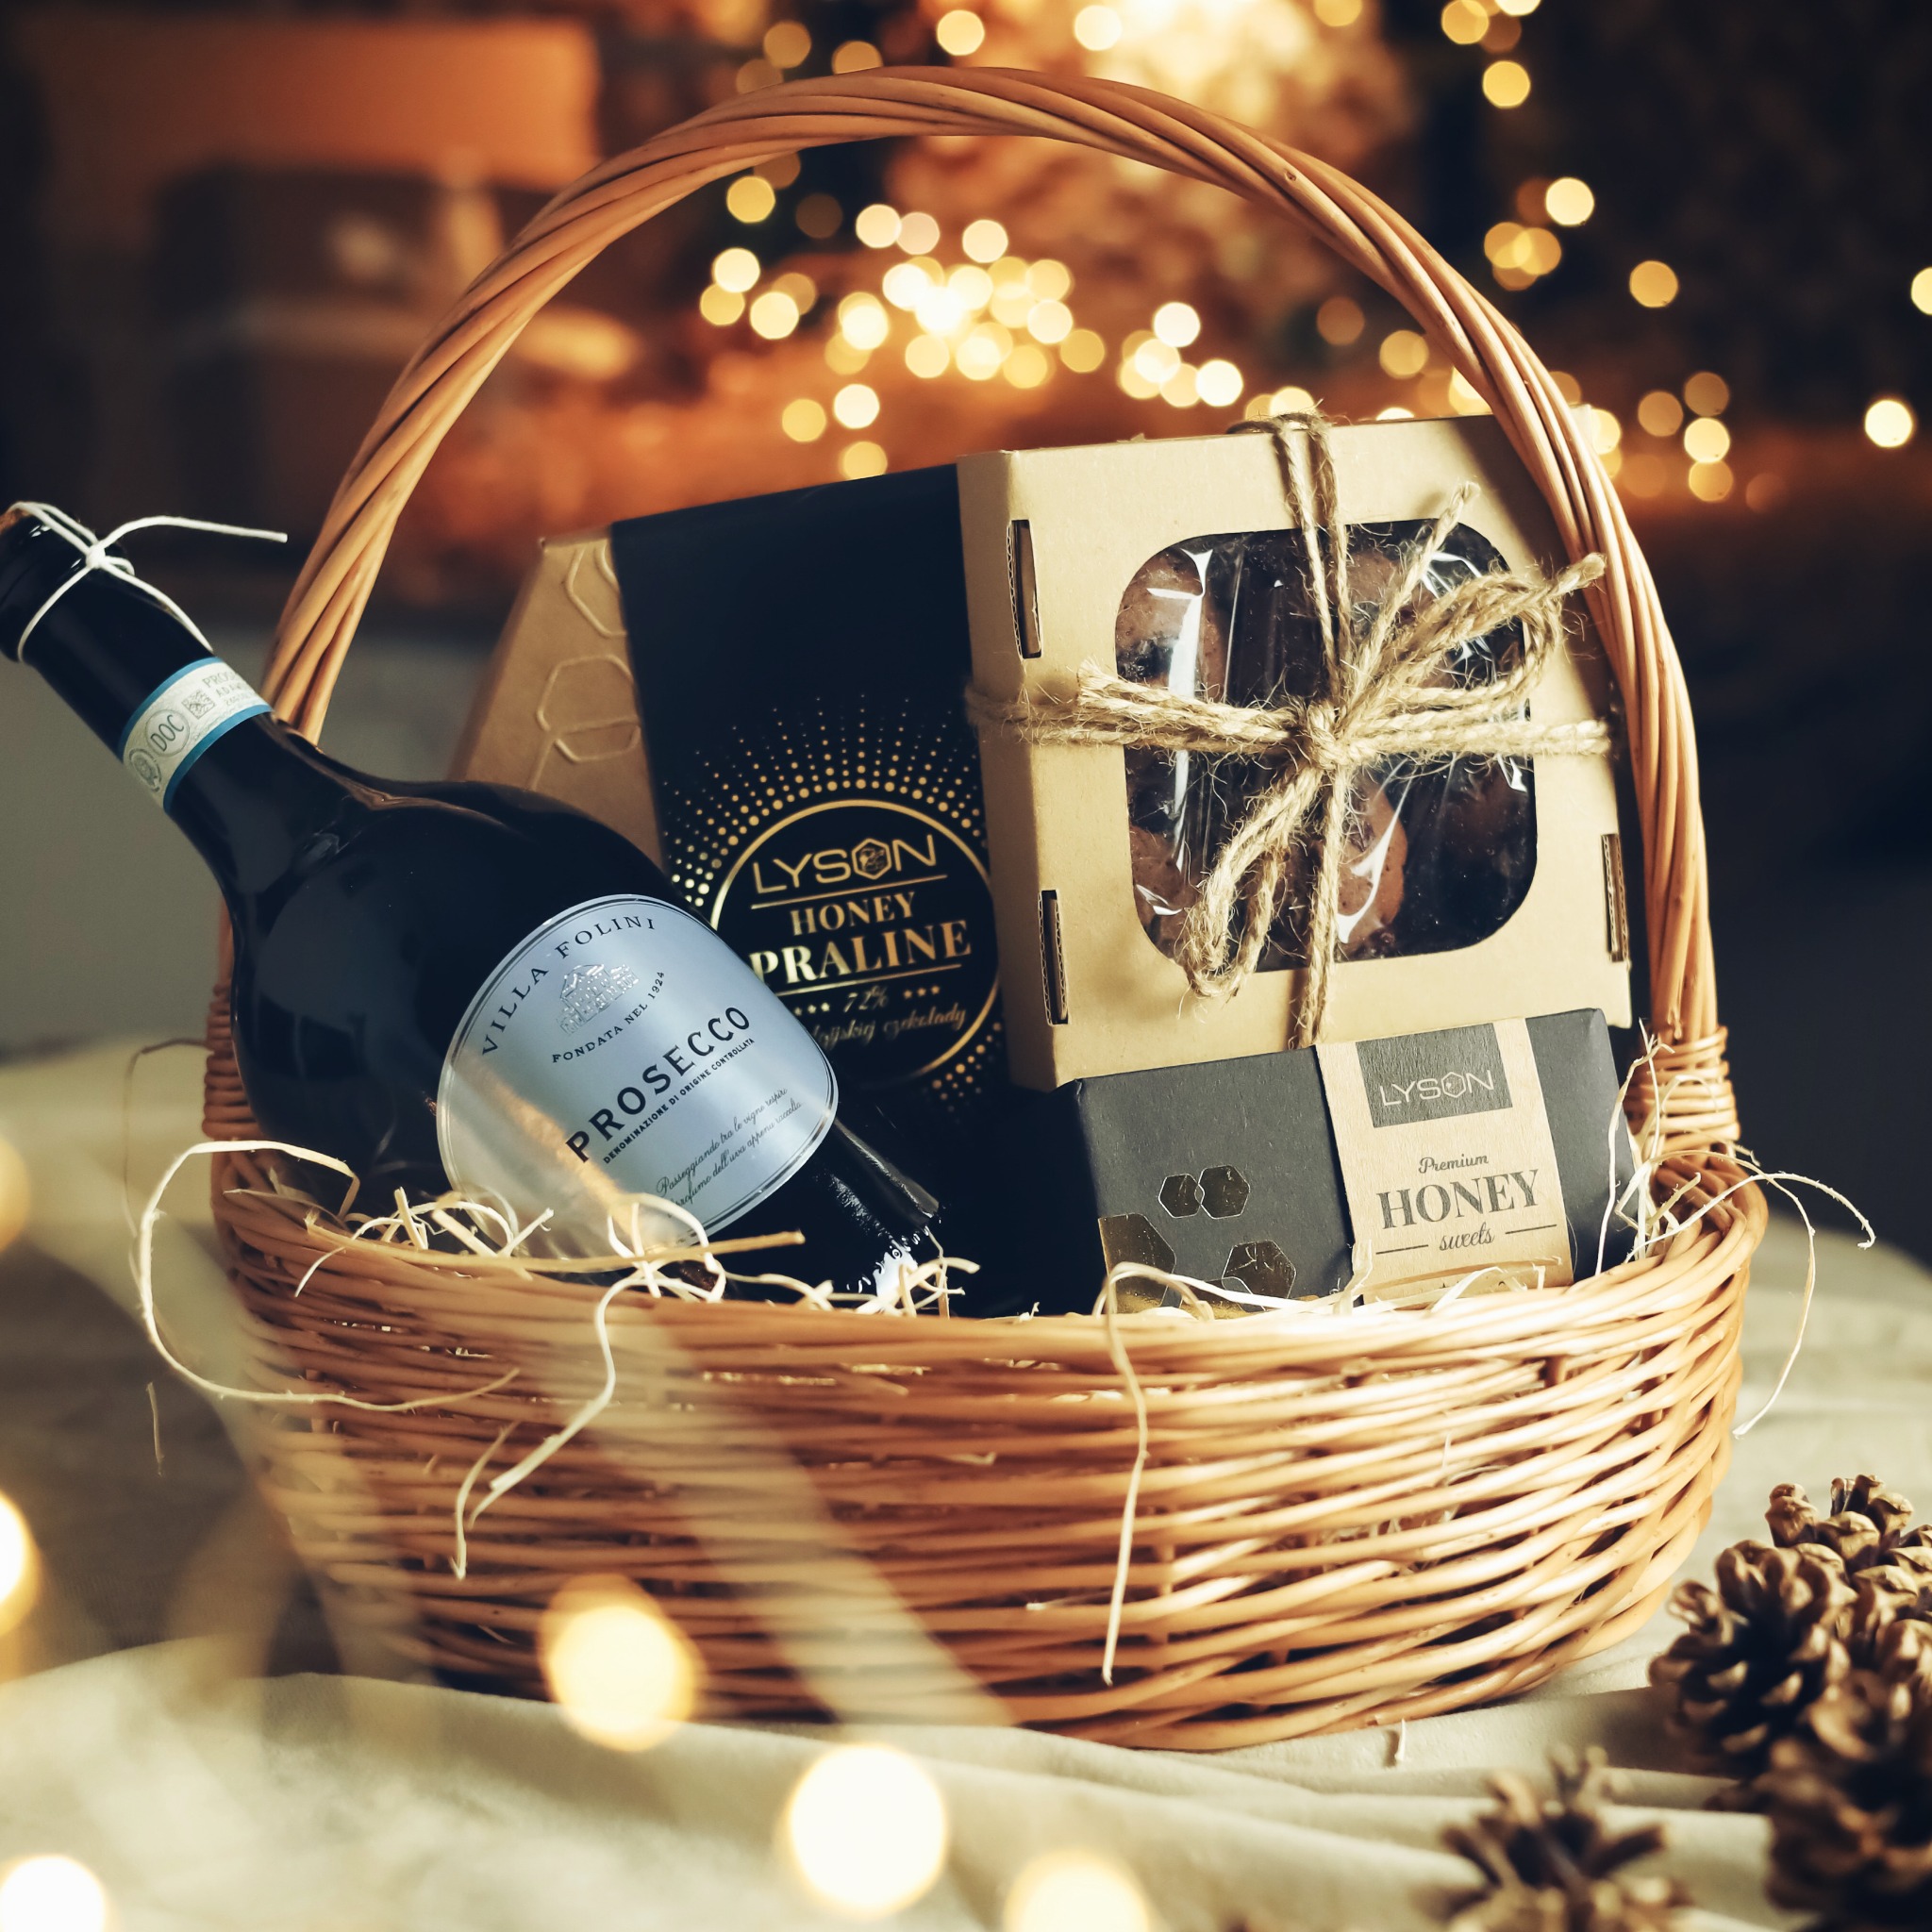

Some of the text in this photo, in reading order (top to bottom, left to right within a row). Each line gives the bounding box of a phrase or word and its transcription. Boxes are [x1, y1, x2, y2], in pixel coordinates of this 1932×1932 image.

[150, 714, 185, 752] DOC
[753, 834, 937, 894] LYSON
[790, 891, 916, 936] HONEY
[749, 920, 972, 985] PRALINE
[482, 916, 655, 1055] VILLA FOLINI
[843, 985, 889, 1012] 72%
[552, 971, 665, 1063] FONDATA NEL 1924
[565, 1007, 750, 1163] PROSECCO
[603, 1037, 756, 1164] DENOMINAZIONE DI ORIGINE CONTROLLATA
[1379, 1070, 1494, 1107] LYSON
[656, 1139, 720, 1197] Passeggiando
[1418, 1153, 1489, 1174] Premium
[1376, 1169, 1540, 1229] HONEY
[1439, 1222, 1495, 1251] sweets
